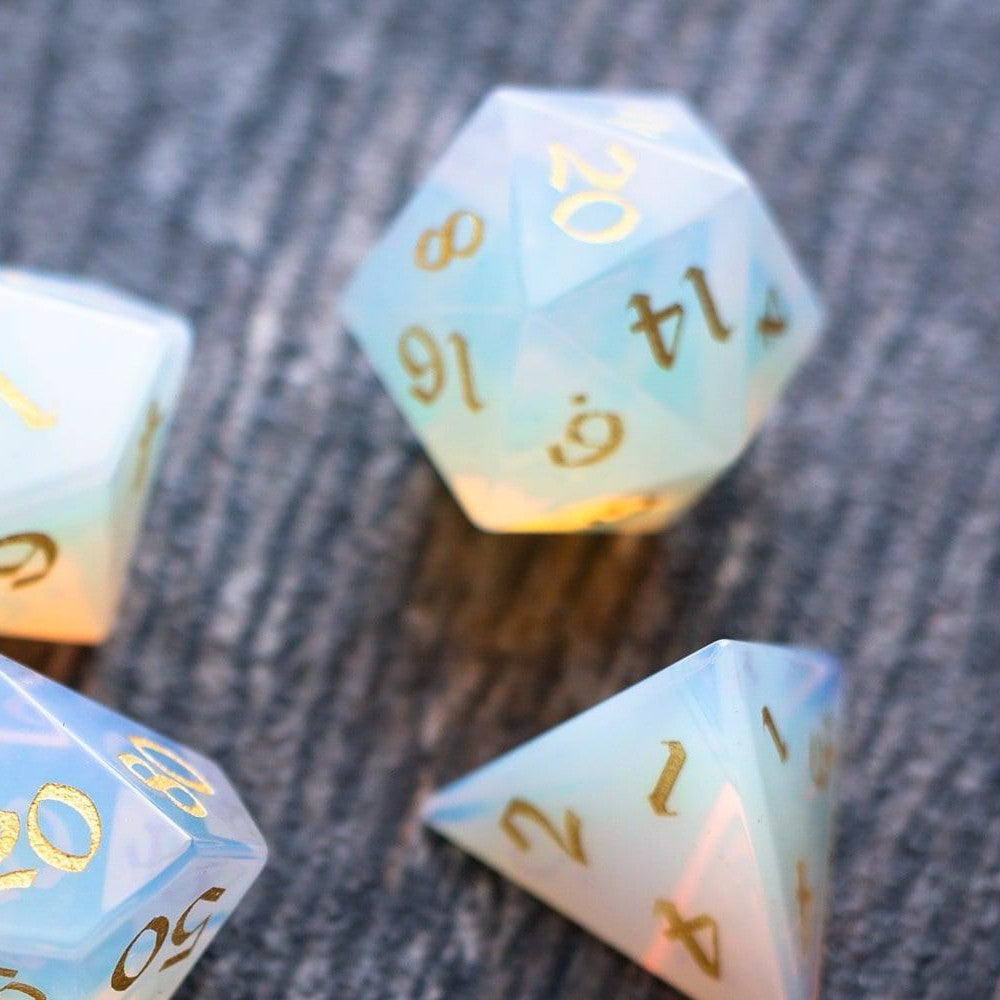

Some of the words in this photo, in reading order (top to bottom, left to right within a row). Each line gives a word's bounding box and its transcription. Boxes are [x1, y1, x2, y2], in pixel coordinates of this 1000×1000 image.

[549, 142, 639, 245] 20
[414, 209, 485, 272] 8
[628, 265, 733, 371] 14
[398, 325, 483, 413] 16
[761, 705, 788, 763] 1
[118, 735, 214, 818] 80
[649, 740, 687, 817] 1
[500, 797, 588, 866] 2
[110, 886, 226, 992] 50
[653, 896, 720, 979] 4
